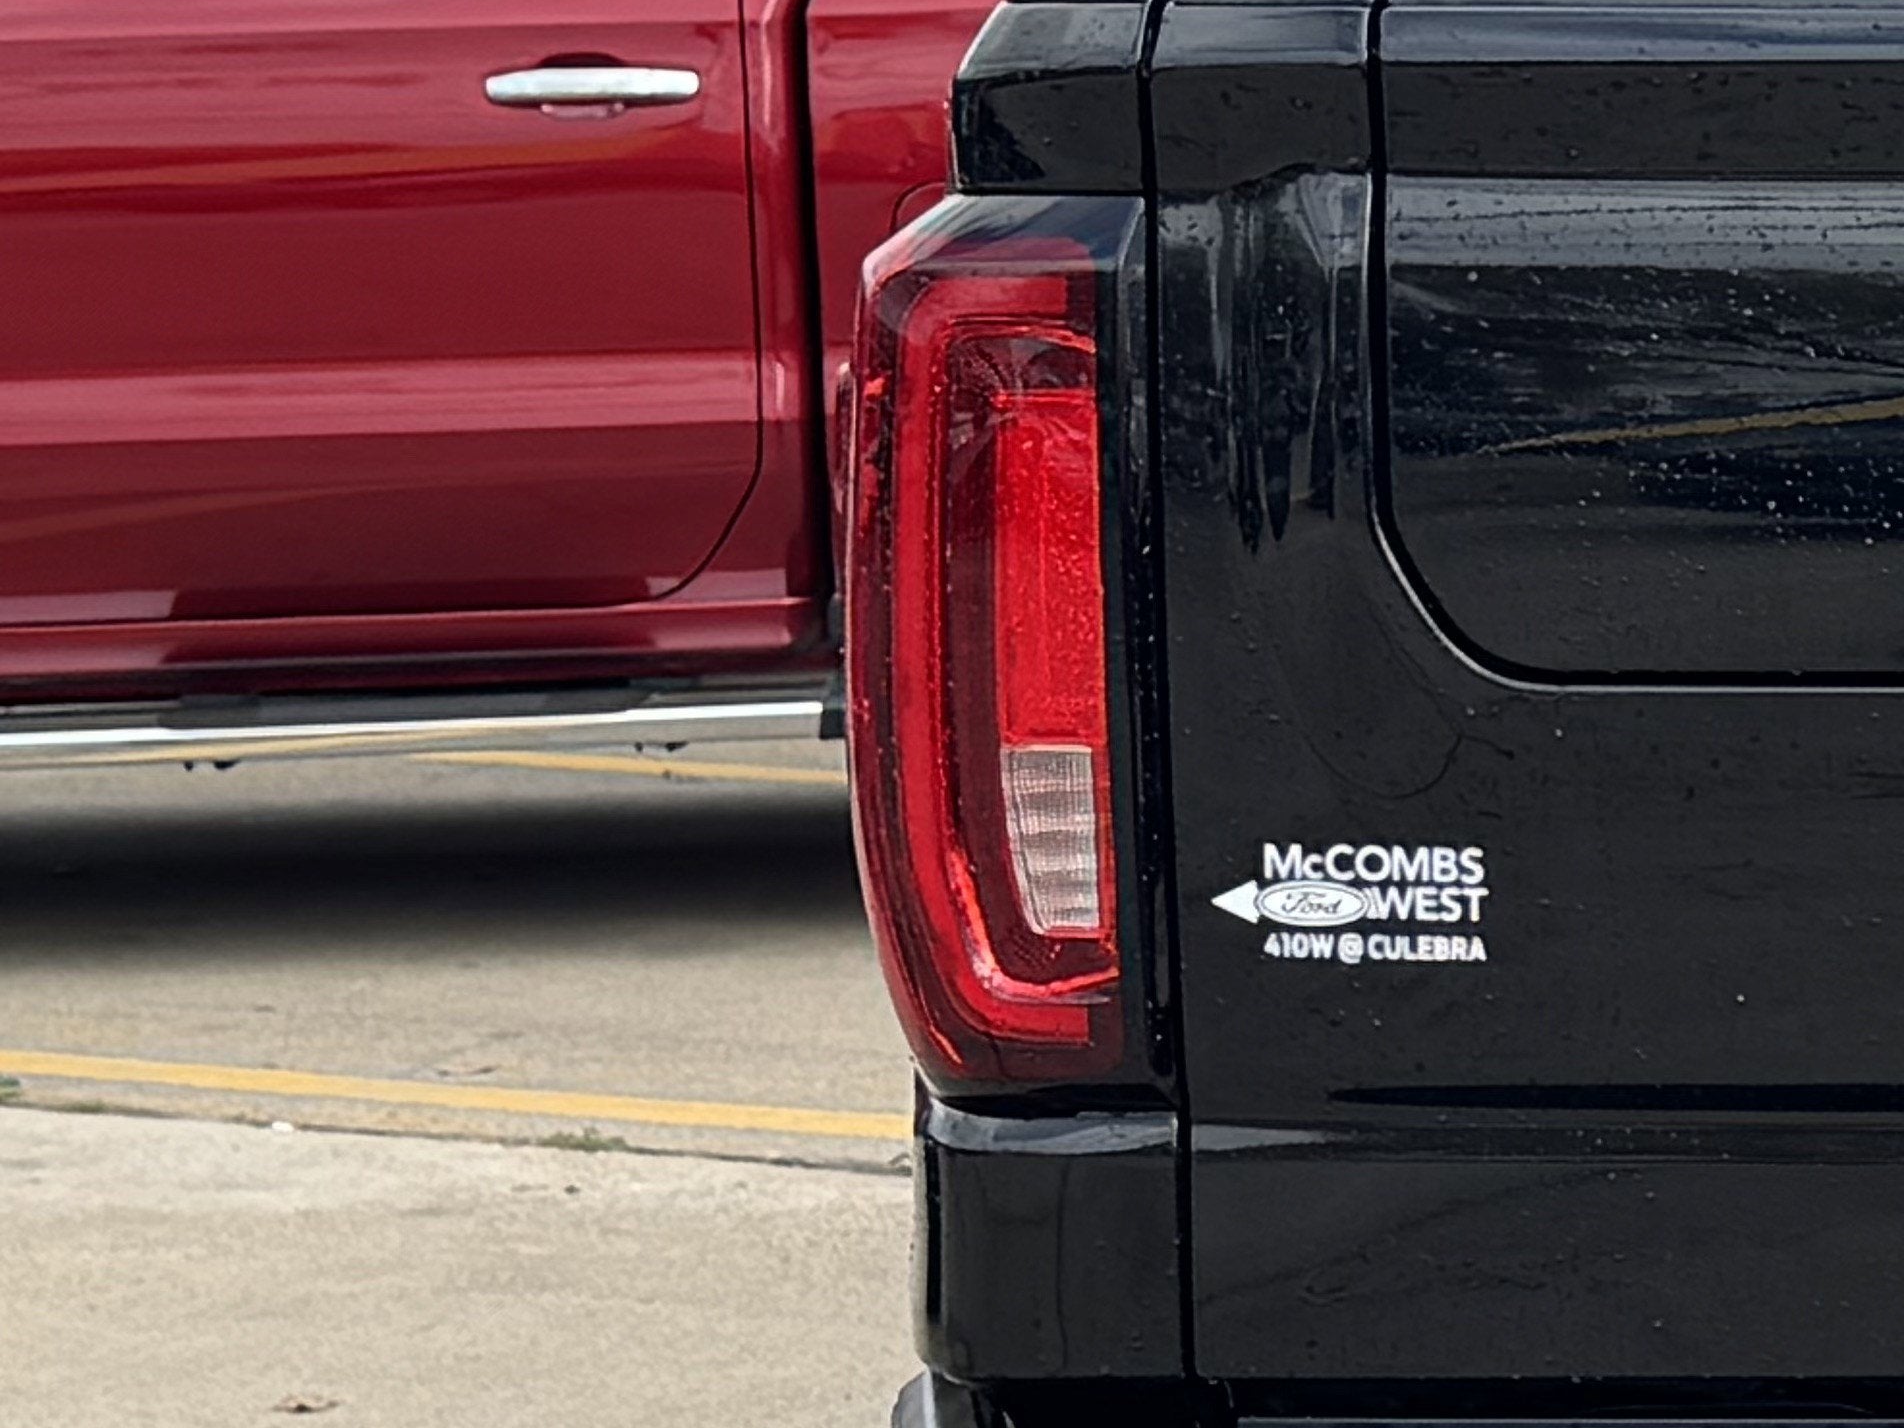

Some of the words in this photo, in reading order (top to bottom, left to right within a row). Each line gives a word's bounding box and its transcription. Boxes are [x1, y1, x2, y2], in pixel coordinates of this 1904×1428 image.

[1262, 842, 1486, 885] McCOMBS
[1366, 885, 1490, 923] WEST
[1263, 932, 1334, 959] 410W
[1367, 935, 1488, 962] CULEBRA
